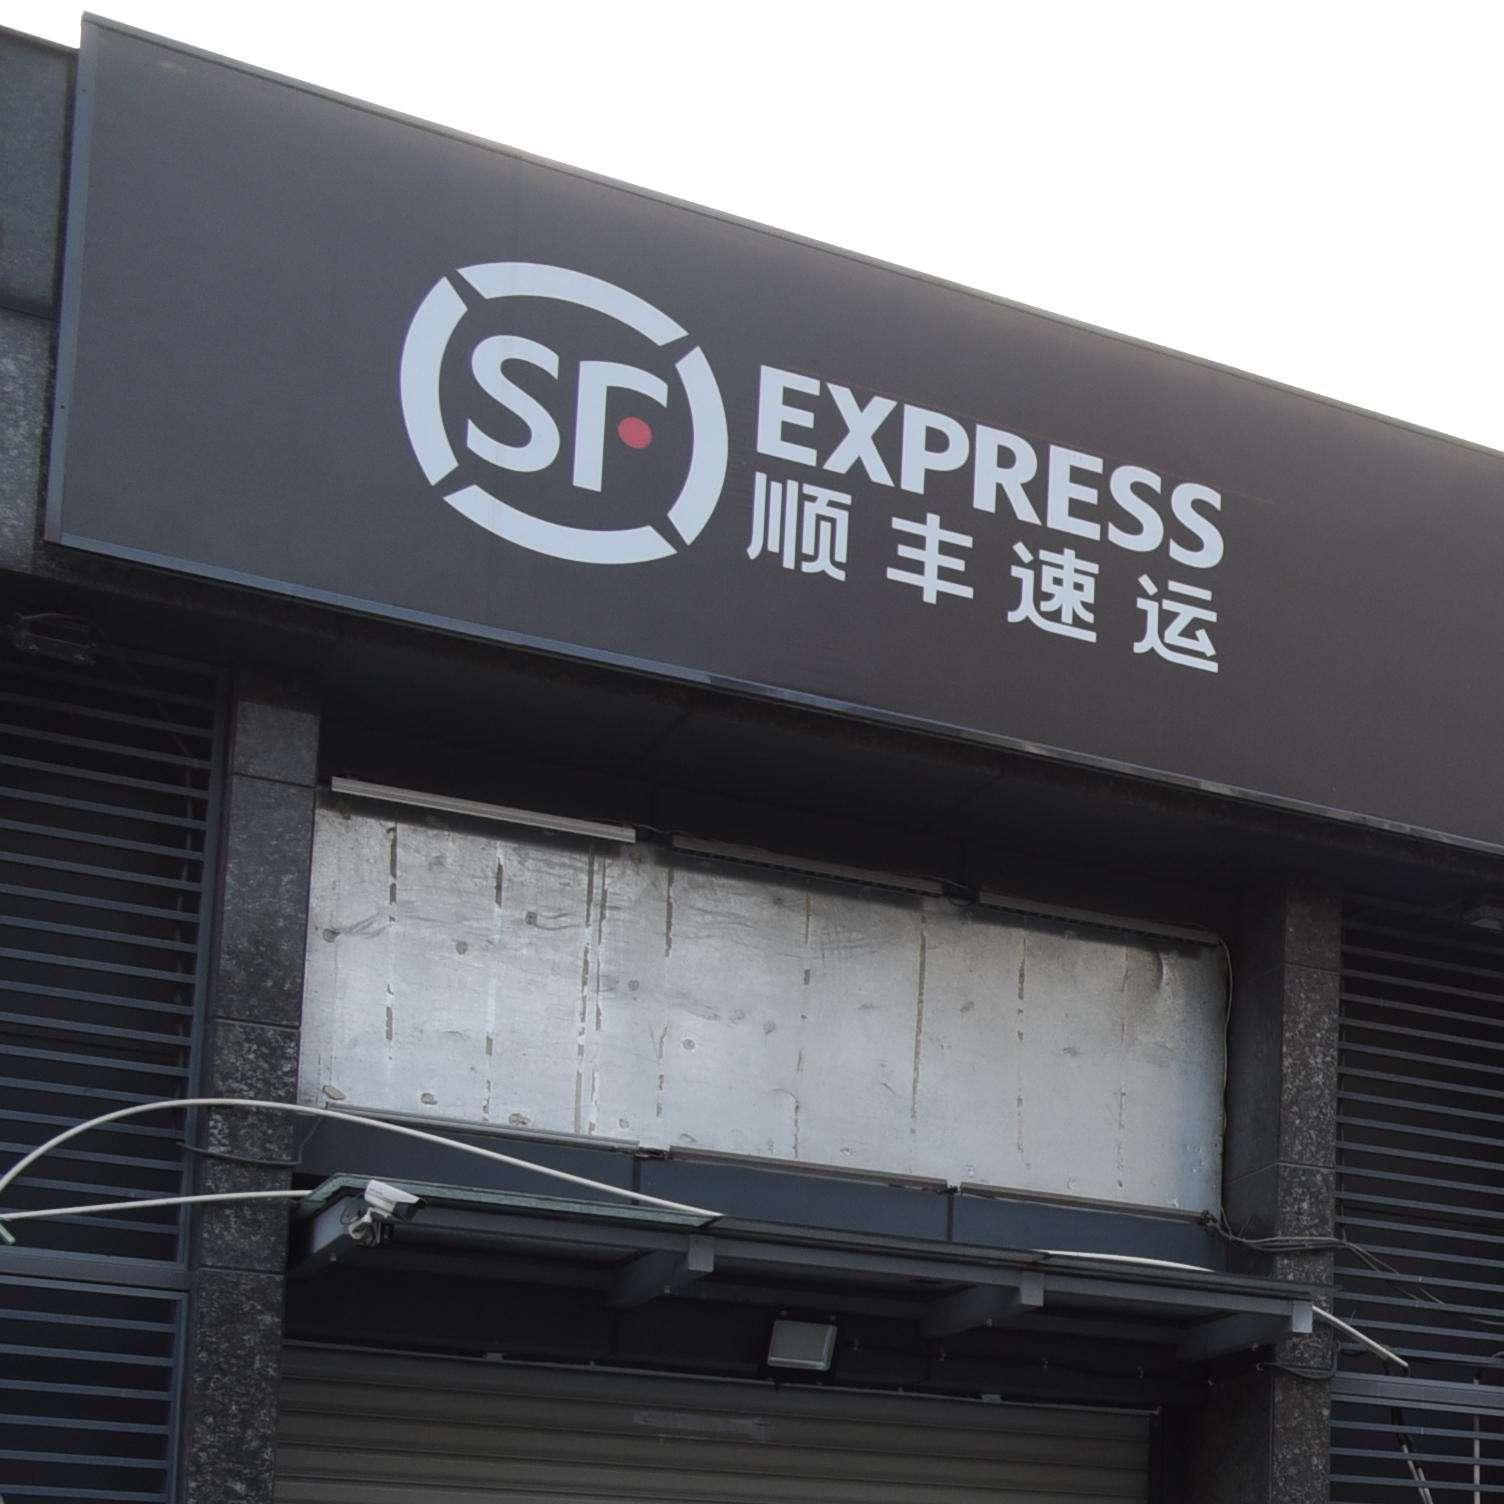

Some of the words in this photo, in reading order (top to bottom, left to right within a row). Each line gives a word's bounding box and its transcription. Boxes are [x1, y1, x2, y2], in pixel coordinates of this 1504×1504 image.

[465, 334, 669, 493] SF
[757, 364, 1225, 571] EXPRESS
[747, 472, 1219, 674] 顺丰速运
